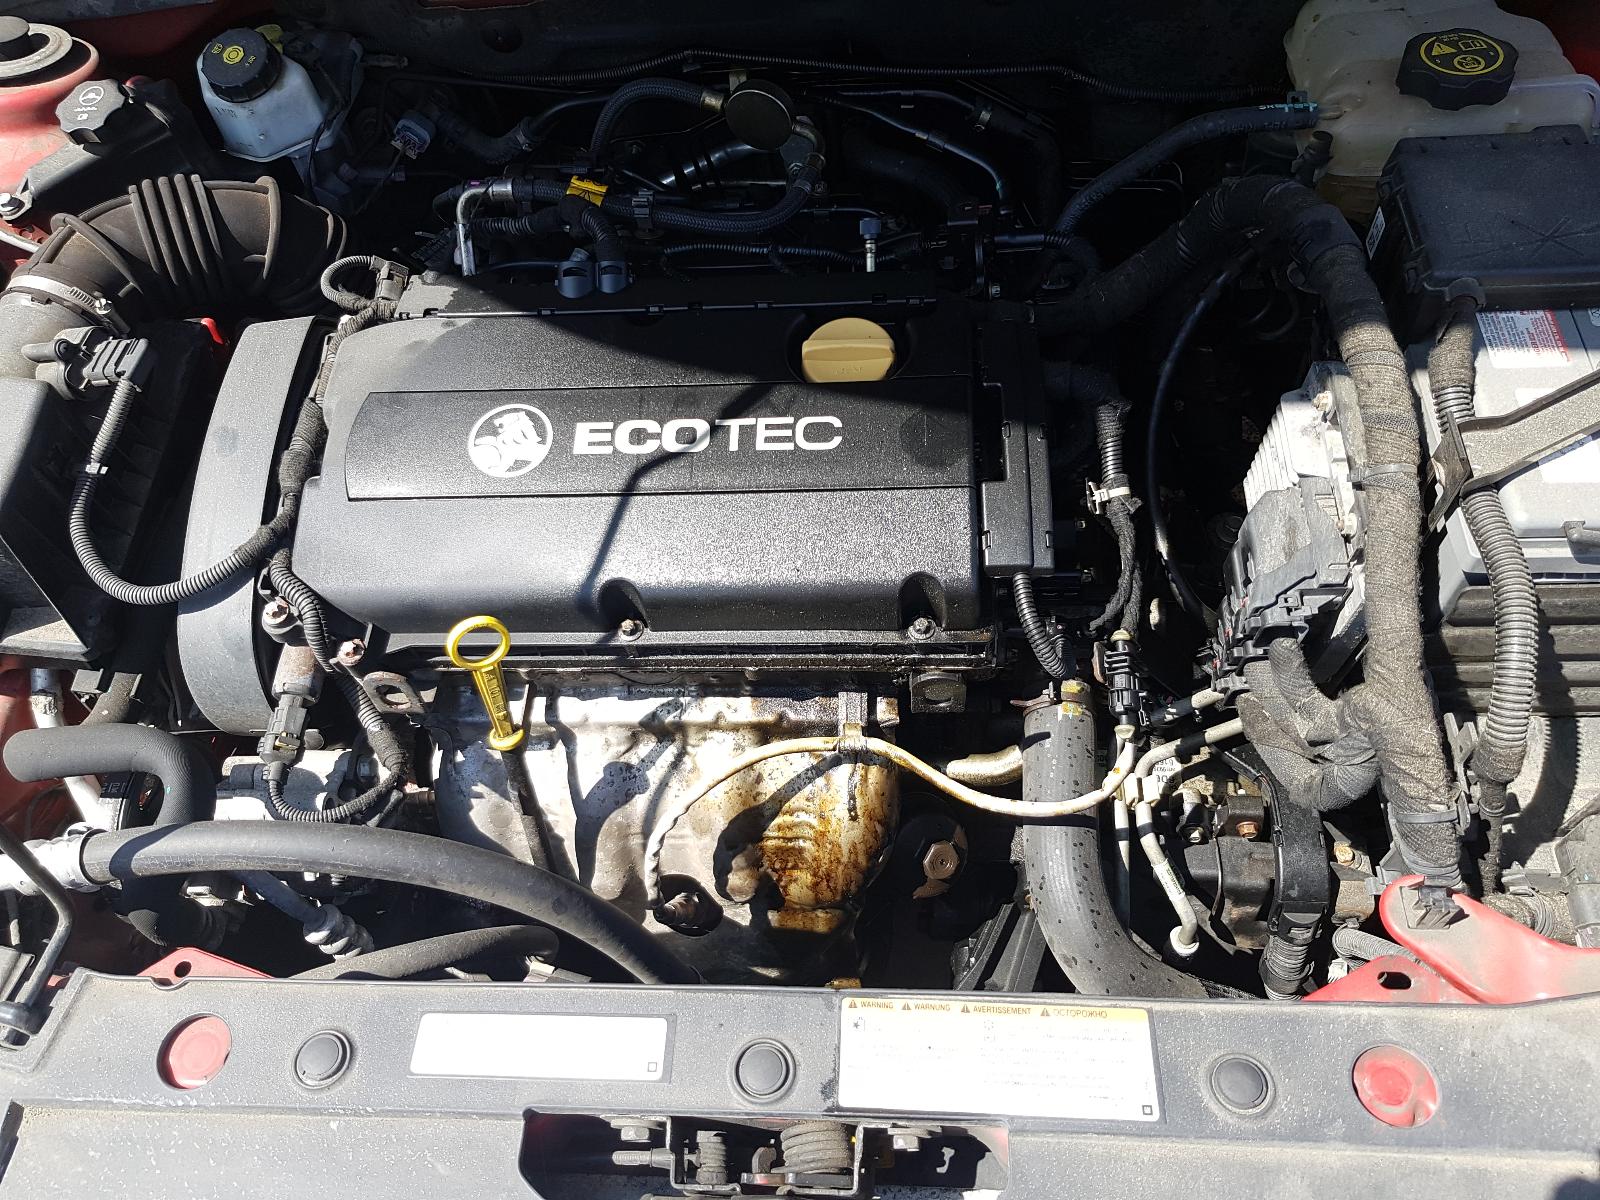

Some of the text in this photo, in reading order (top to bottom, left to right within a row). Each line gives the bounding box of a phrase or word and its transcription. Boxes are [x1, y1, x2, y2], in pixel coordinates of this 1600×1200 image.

[573, 415, 843, 455] ECOTEC
[860, 1000, 894, 1010] WARNING
[914, 1002, 951, 1012] WARNUNG
[973, 1005, 1032, 1015] AVERTISSEMENT
